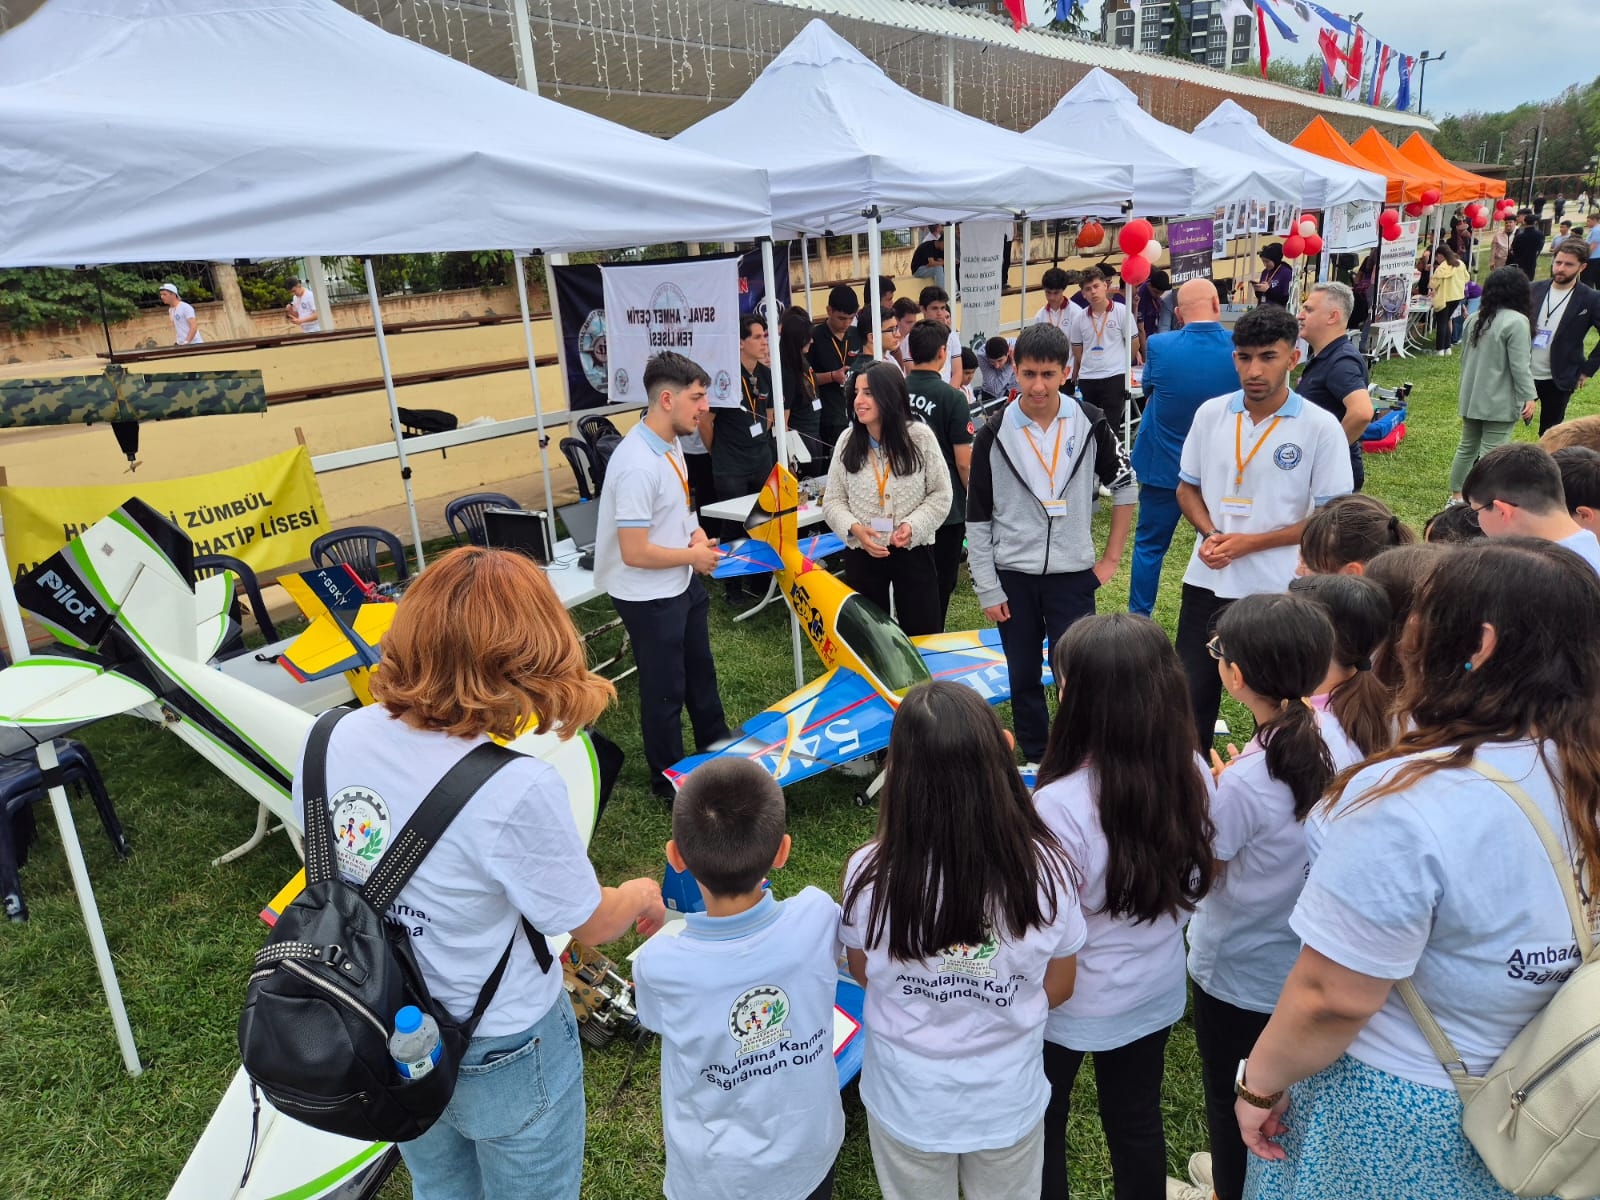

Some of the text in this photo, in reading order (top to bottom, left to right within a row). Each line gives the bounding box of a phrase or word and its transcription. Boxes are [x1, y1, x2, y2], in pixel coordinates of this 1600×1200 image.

[184, 492, 273, 529] ZÜMBÜL
[194, 505, 319, 556] HATİP LİSESİ
[36, 569, 96, 624] Pilot
[895, 974, 979, 988] Ambalajına
[792, 1043, 824, 1066] Olma
